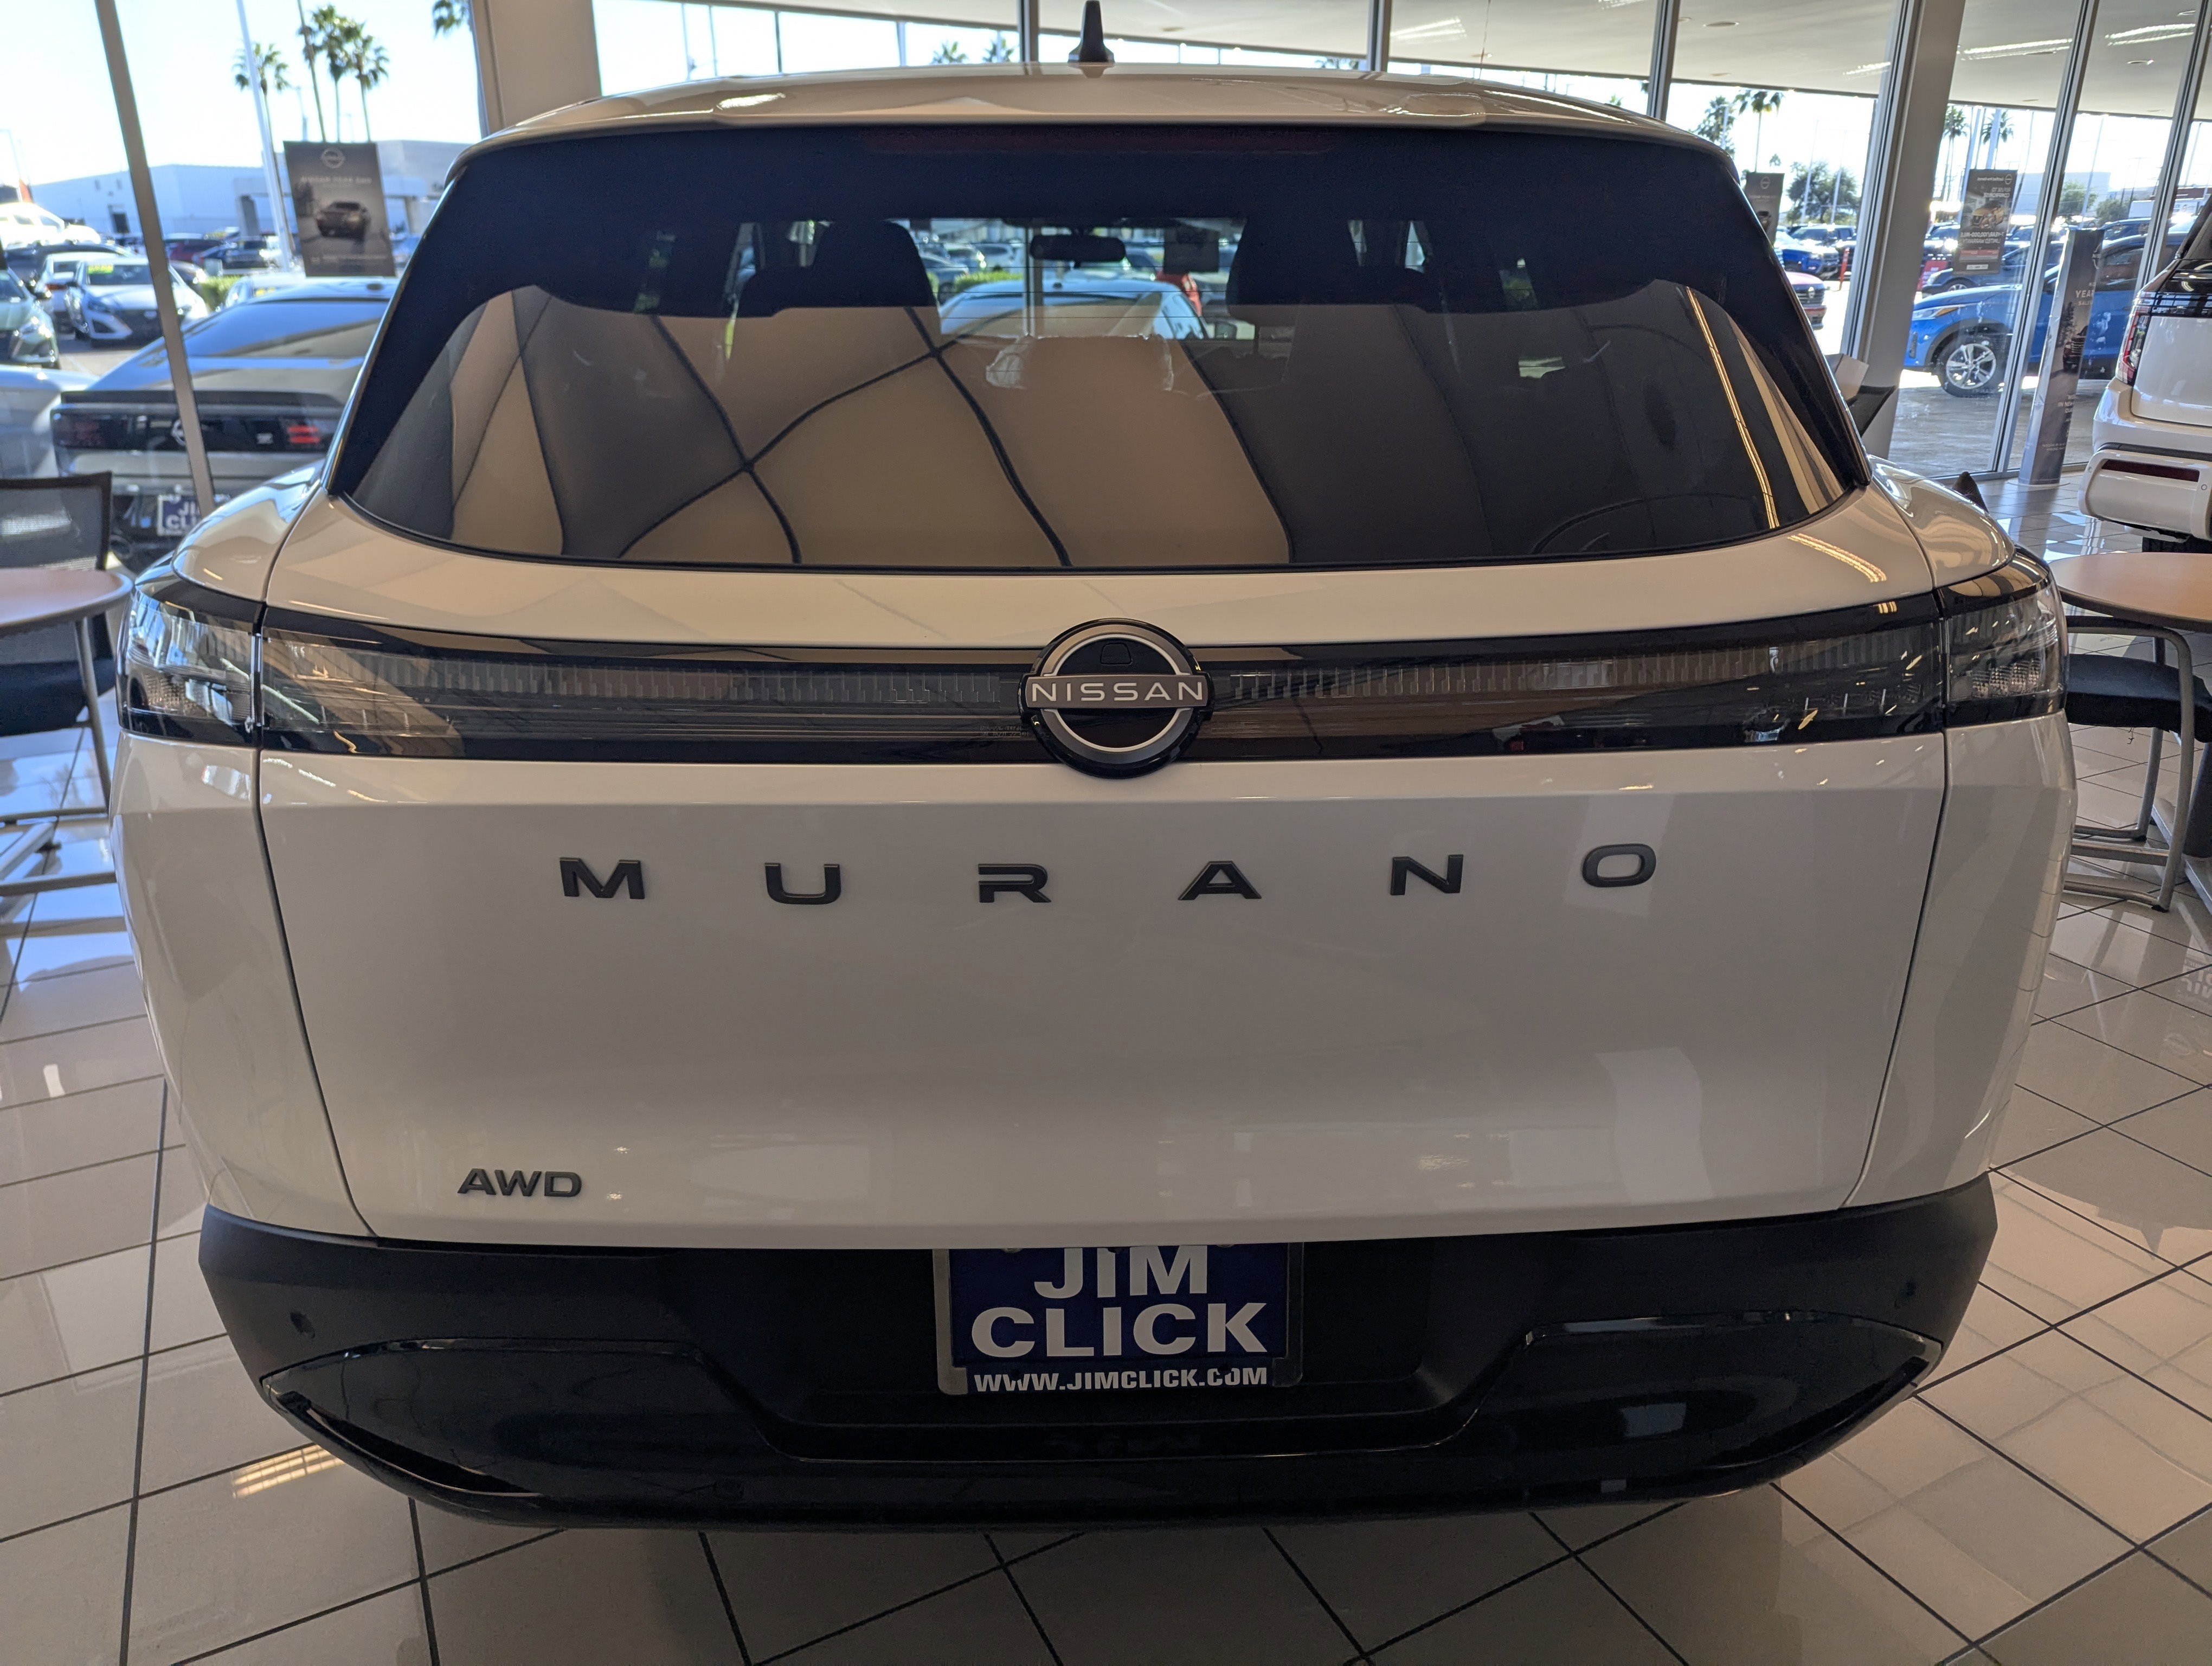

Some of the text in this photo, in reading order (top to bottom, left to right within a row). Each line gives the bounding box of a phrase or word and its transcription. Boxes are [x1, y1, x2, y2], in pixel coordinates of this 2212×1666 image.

[179, 501, 200, 516] JI
[1032, 681, 1203, 702] NISSAN
[559, 843, 1657, 905] MURANO
[457, 1168, 582, 1197] AWD
[1034, 1244, 1208, 1299] JIM
[971, 1302, 1268, 1359] CLICK
[974, 1367, 1268, 1392] WWW.JIMCLICK.COM
